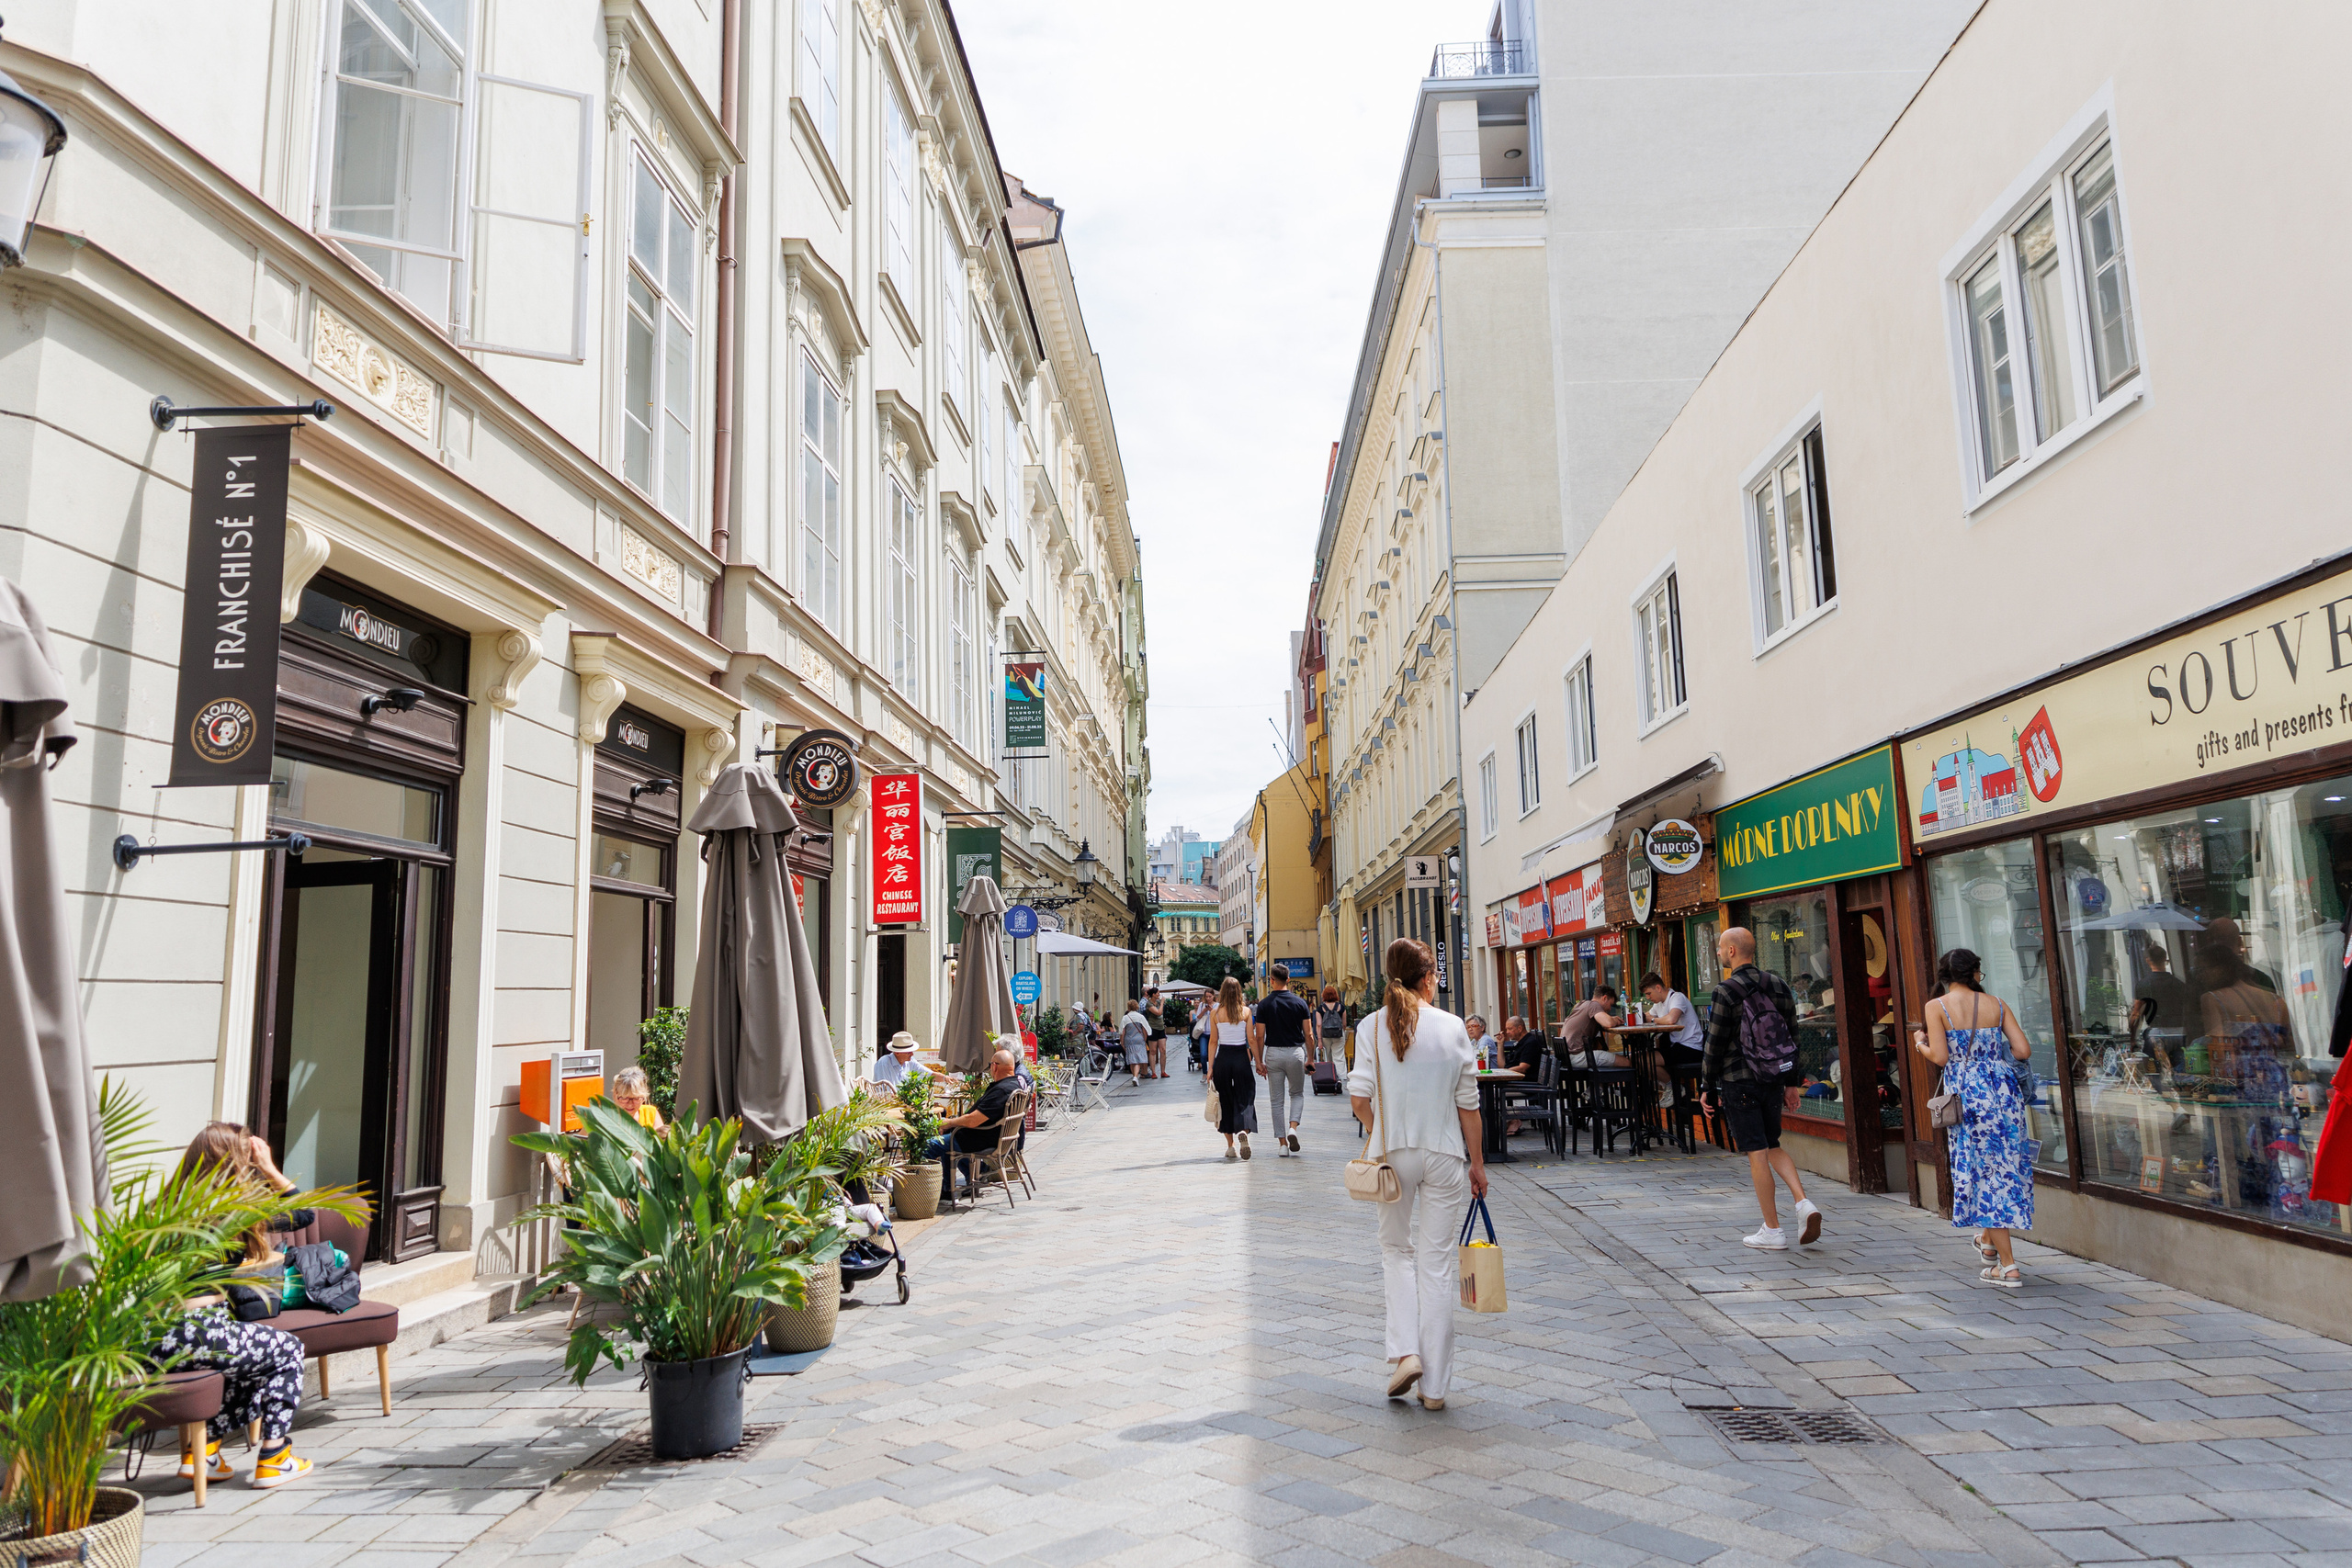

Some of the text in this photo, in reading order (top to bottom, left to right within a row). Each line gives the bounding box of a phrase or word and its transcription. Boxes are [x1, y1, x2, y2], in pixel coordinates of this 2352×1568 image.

[214, 515, 254, 670] FRANCHISÉ
[340, 607, 400, 650] MONDIEU
[200, 702, 251, 725] MONDIEU
[617, 723, 649, 750] MONDIEU
[2197, 730, 2229, 769] gifts
[2234, 717, 2259, 750] and
[2266, 704, 2333, 751] presents
[797, 745, 849, 770] MONDIEU
[794, 772, 808, 795] Organic
[808, 791, 827, 801] Bistro
[828, 792, 834, 800] &
[880, 780, 914, 885] 华丽宫饭店
[1723, 784, 1883, 870] MÓDNE DOPLNKY
[1654, 841, 1696, 854] NARCOS
[1630, 868, 1649, 889] NARCOS
[876, 901, 919, 915] RESTAURANT
[882, 889, 912, 901] CHINESE
